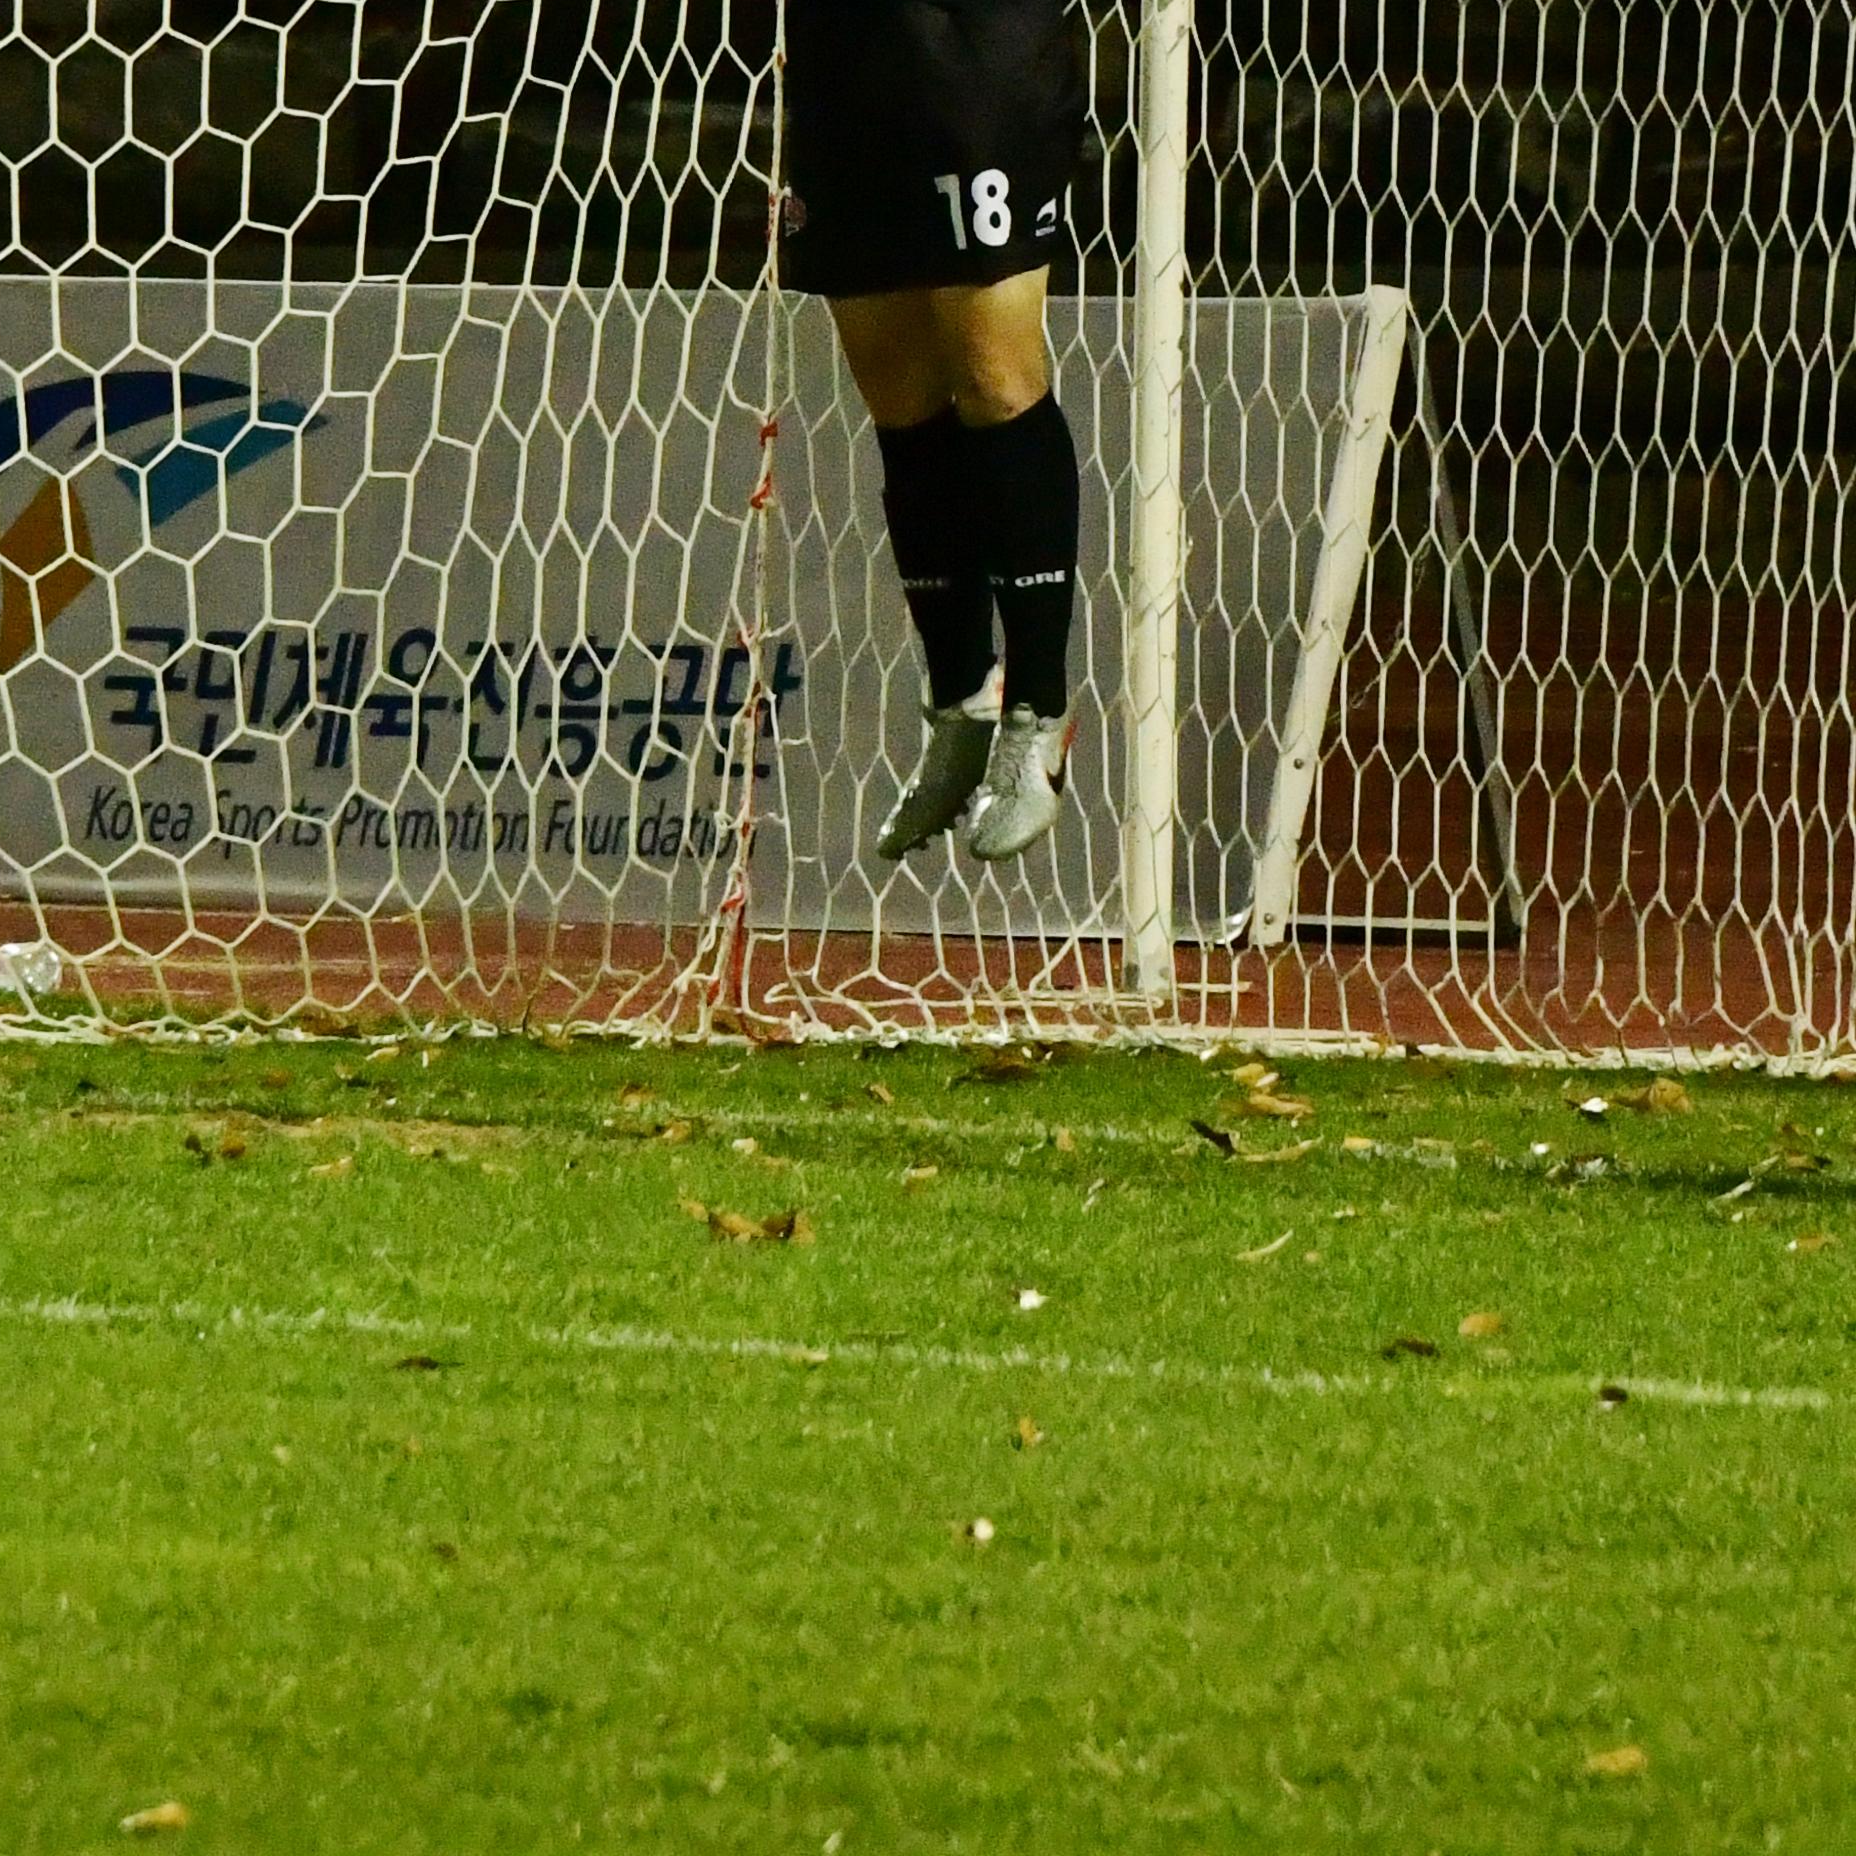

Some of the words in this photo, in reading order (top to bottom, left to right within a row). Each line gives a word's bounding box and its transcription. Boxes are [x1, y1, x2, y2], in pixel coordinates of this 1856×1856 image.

[934, 169, 1012, 250] 18
[104, 627, 801, 781] 국민체육진흥공단
[85, 785, 193, 842] Korea
[214, 789, 325, 859] Sports
[336, 793, 528, 854] Promotion
